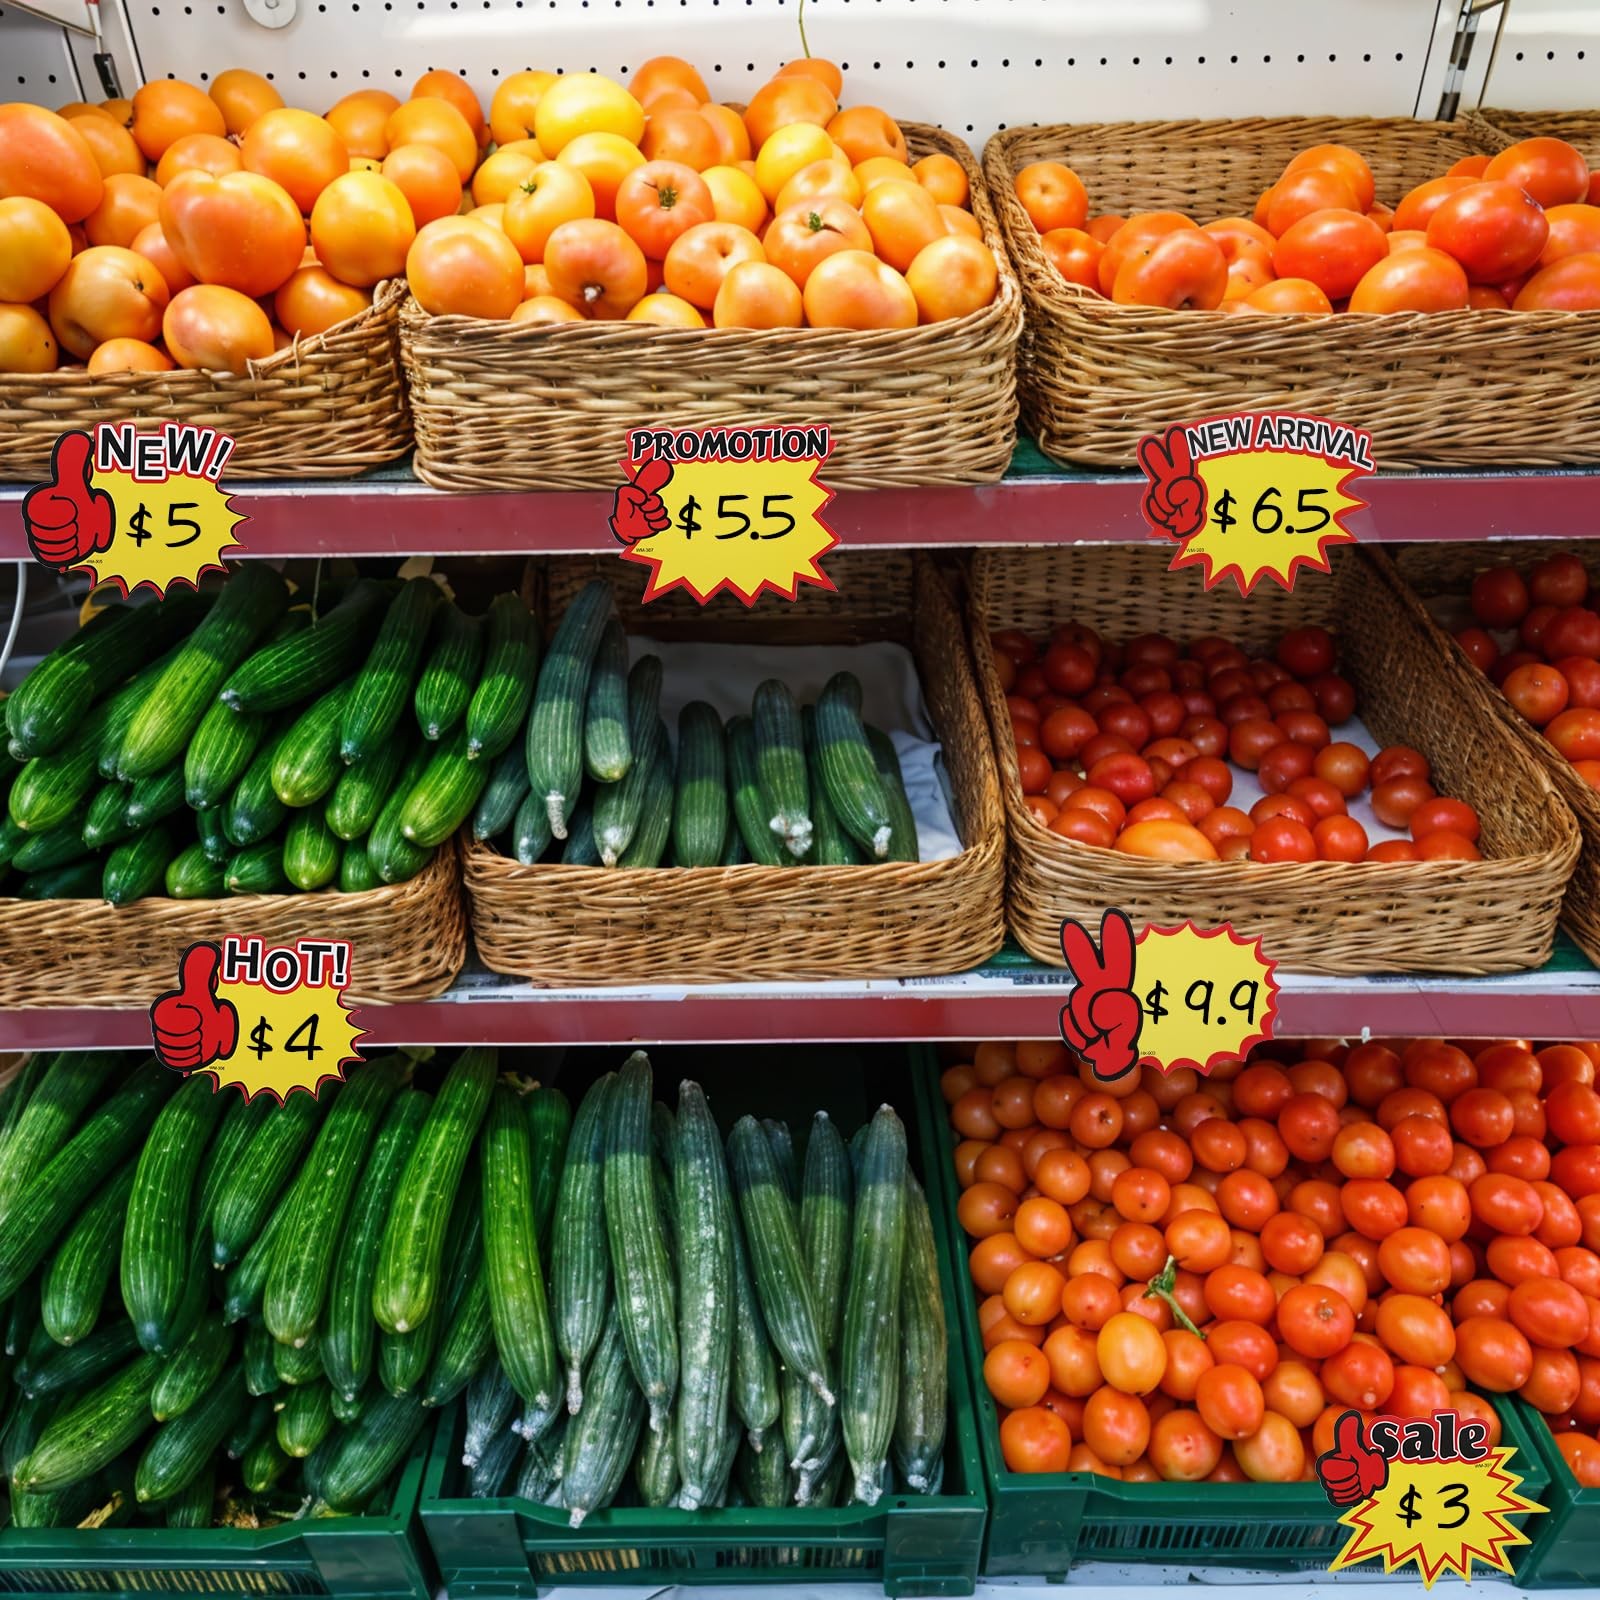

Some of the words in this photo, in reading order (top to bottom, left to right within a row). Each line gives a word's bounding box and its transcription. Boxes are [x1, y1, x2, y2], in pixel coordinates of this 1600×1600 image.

[100, 426, 235, 477] NEW!
[631, 428, 830, 461] PROMOTION
[1186, 417, 1252, 459] NEW
[1257, 417, 1373, 469] ARRIVAL
[1370, 1414, 1488, 1459] sale
